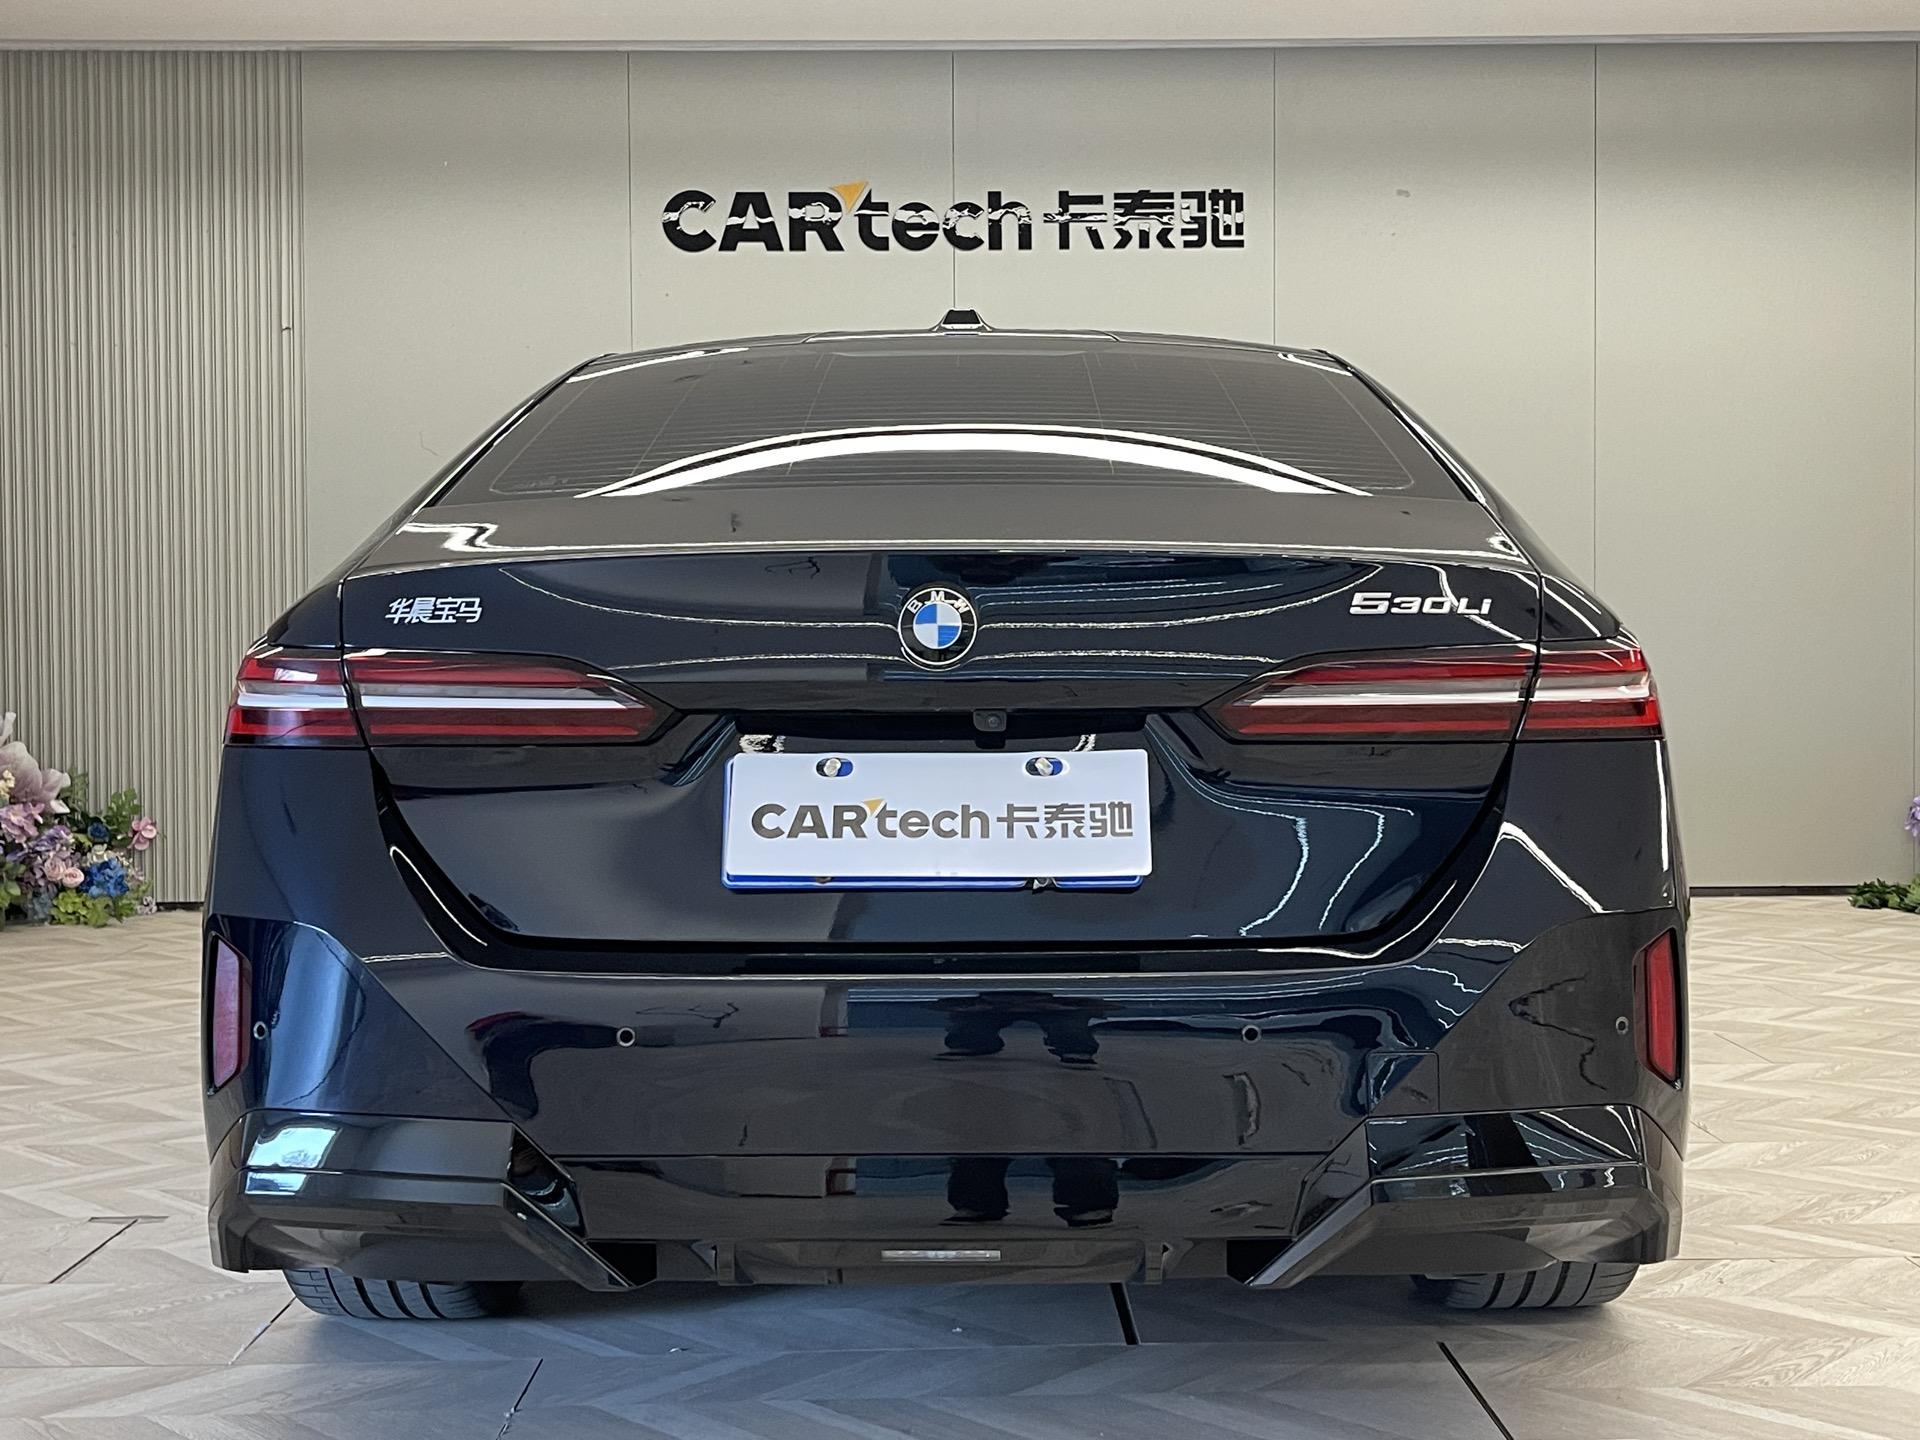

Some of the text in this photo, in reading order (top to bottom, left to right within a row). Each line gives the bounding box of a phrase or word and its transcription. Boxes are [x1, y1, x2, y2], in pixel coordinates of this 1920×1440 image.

[662, 182, 1245, 252] CARtech 卡泰驰
[384, 596, 482, 624] 华晨宝马
[906, 590, 970, 614] BMW
[1350, 592, 1492, 615] 530Li
[751, 799, 1134, 839] CARtech 卡泰驰
